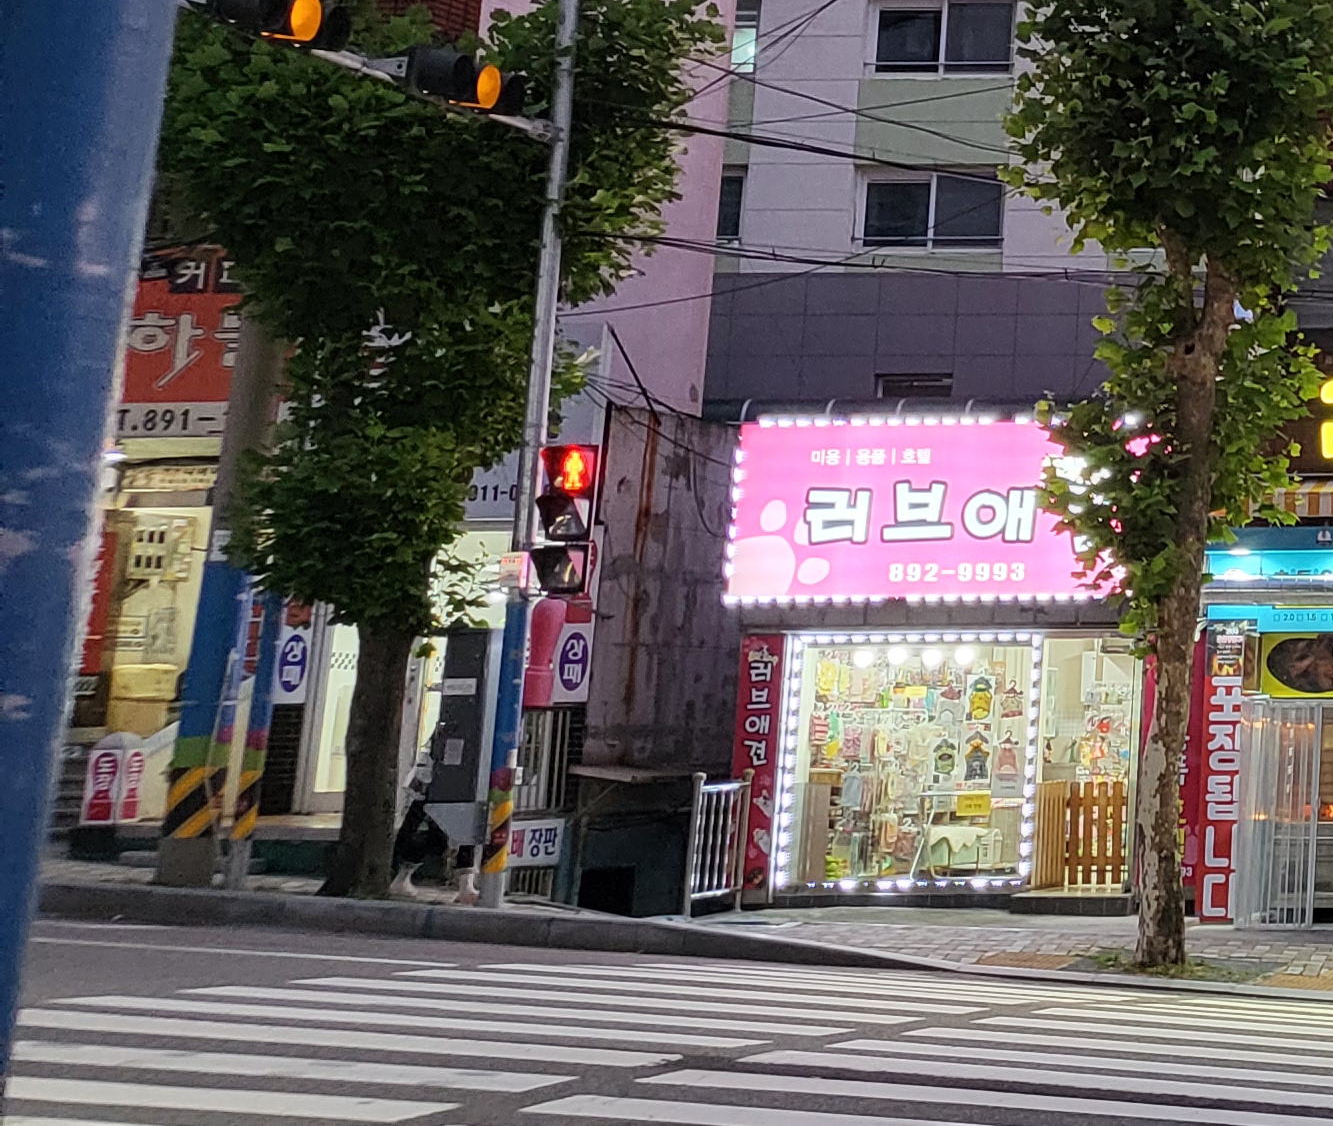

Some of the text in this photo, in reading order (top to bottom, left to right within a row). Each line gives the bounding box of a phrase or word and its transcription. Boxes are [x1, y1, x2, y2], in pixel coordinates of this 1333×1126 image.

[811, 447, 841, 466] 미용
[901, 447, 932, 466] 호텔
[804, 479, 1055, 546] 러브애
[888, 561, 1026, 583] 892-9993
[743, 661, 773, 767] 러브애견
[529, 826, 558, 858] 장판
